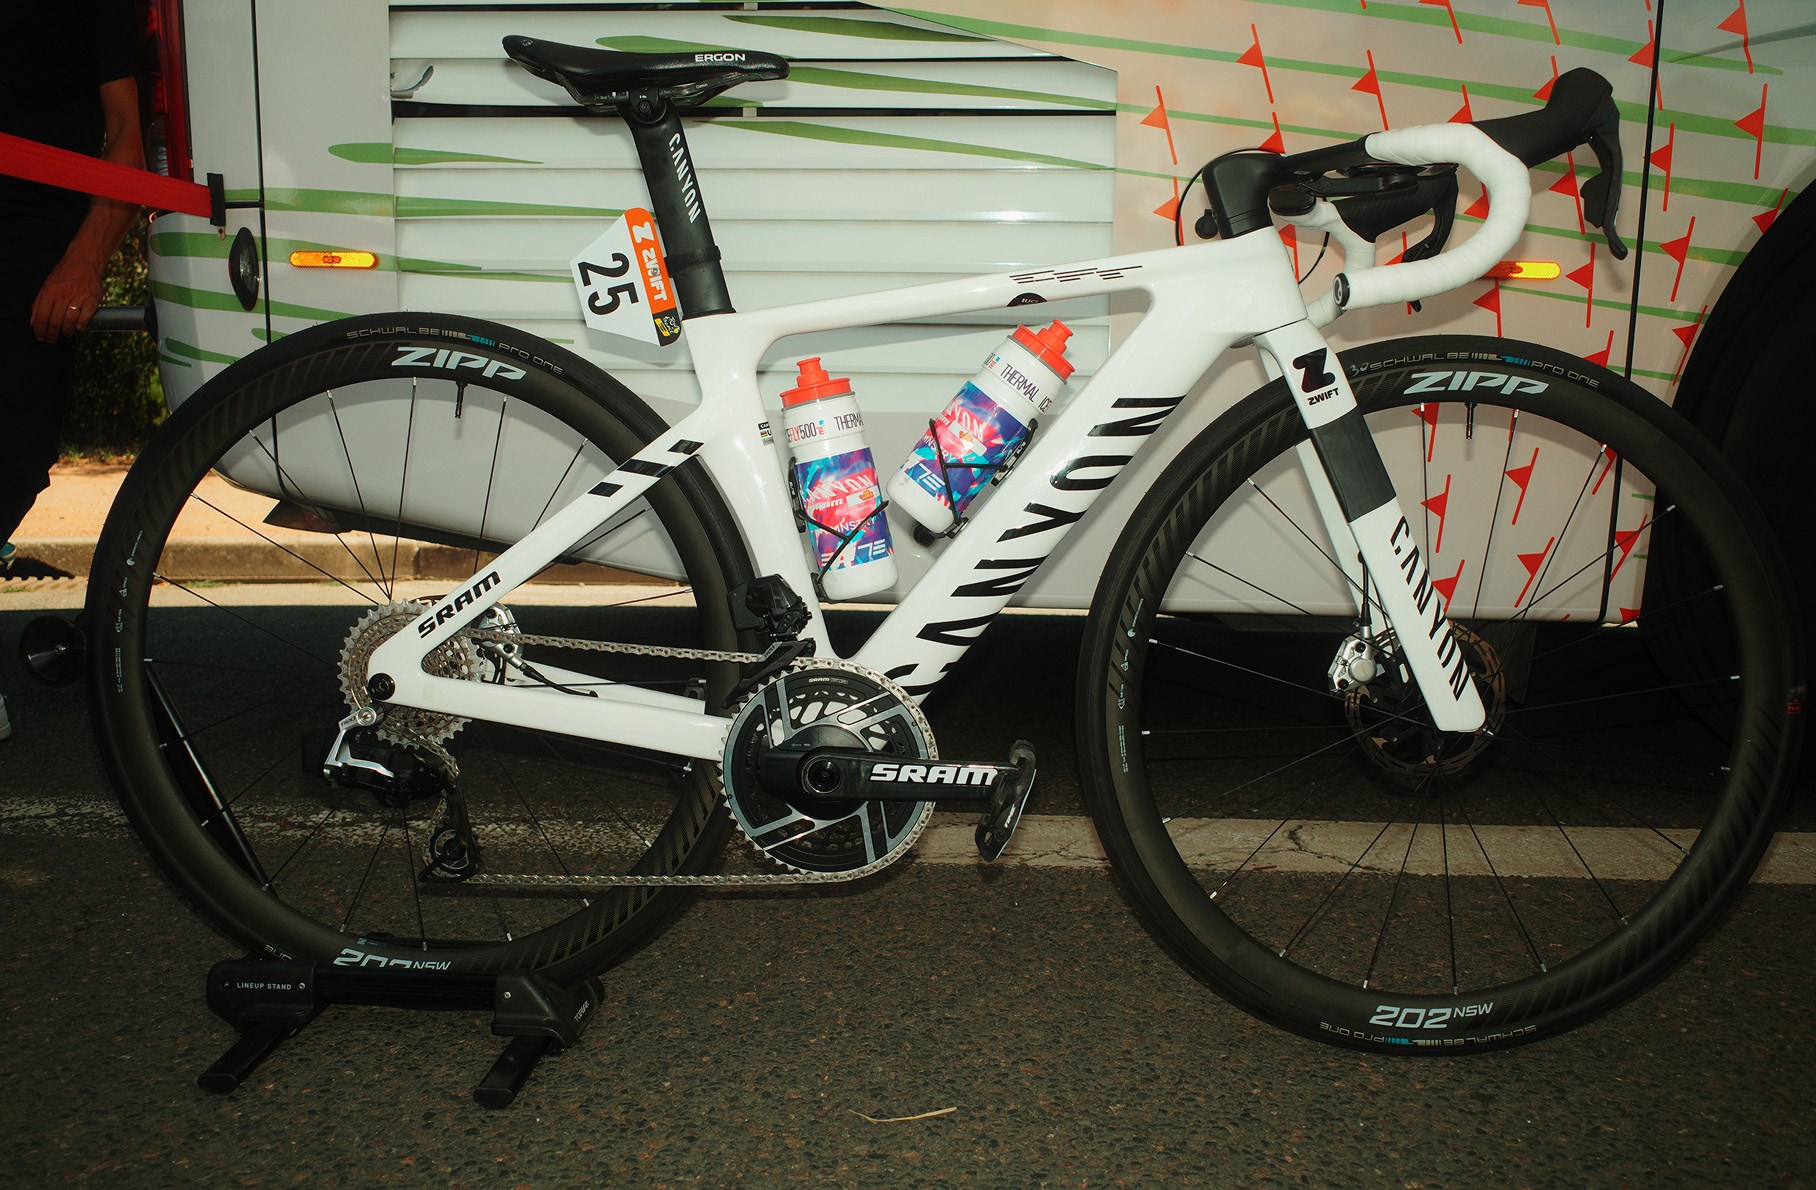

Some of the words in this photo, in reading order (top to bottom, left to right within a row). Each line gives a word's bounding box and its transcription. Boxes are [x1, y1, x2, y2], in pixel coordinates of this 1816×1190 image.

[695, 54, 746, 62] ERGON
[668, 132, 700, 224] CANYON
[578, 253, 640, 316] 25
[346, 326, 440, 340] SCHWALBE
[391, 346, 527, 380] ZIPP
[1370, 353, 1469, 371] SCHWALBE
[1000, 363, 1040, 402] THERMAL
[1403, 371, 1550, 395] ZIPP
[1308, 388, 1340, 405] ZWIFT
[884, 395, 1187, 697] CANYON
[418, 571, 501, 639] SRAM
[1390, 515, 1470, 702] CANYON
[870, 763, 999, 786] SRAM
[267, 983, 292, 991] STAND
[1368, 1004, 1453, 1029] 202
[1453, 1002, 1494, 1018] NSW
[1443, 1024, 1537, 1046] SCHWALBE
